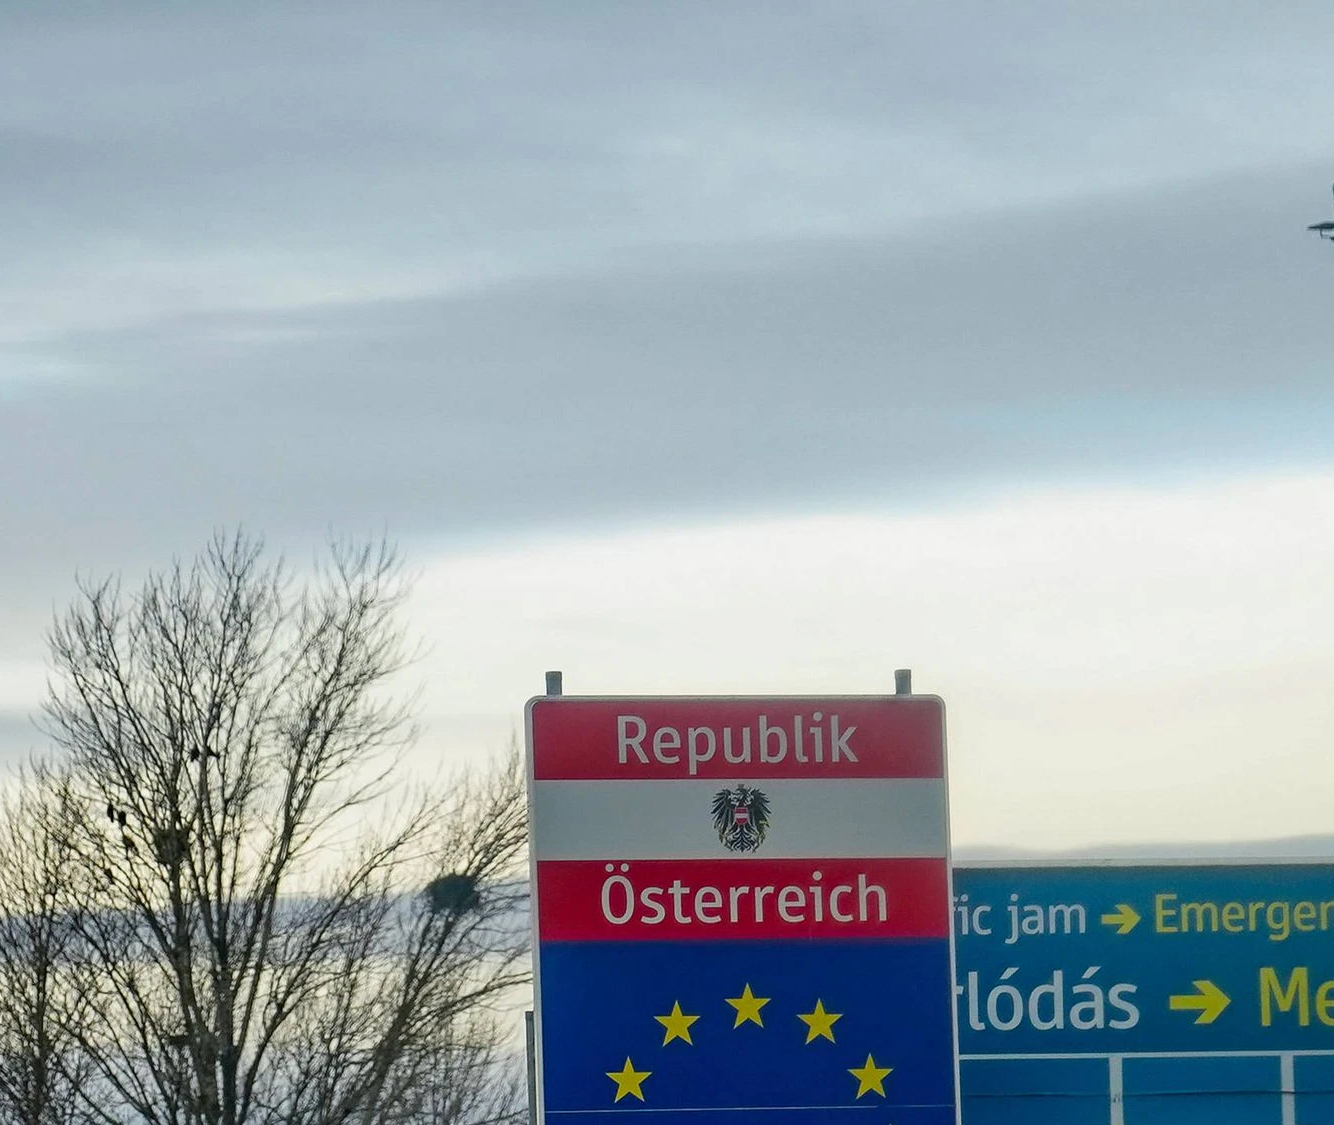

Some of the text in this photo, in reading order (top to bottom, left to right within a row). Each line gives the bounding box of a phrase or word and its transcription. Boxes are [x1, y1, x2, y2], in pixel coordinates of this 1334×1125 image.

[617, 712, 859, 775] Republik
[601, 863, 888, 925] Österreich
[954, 894, 992, 935] ic
[1005, 894, 1086, 944] jam
[956, 966, 1140, 1031] lódás
